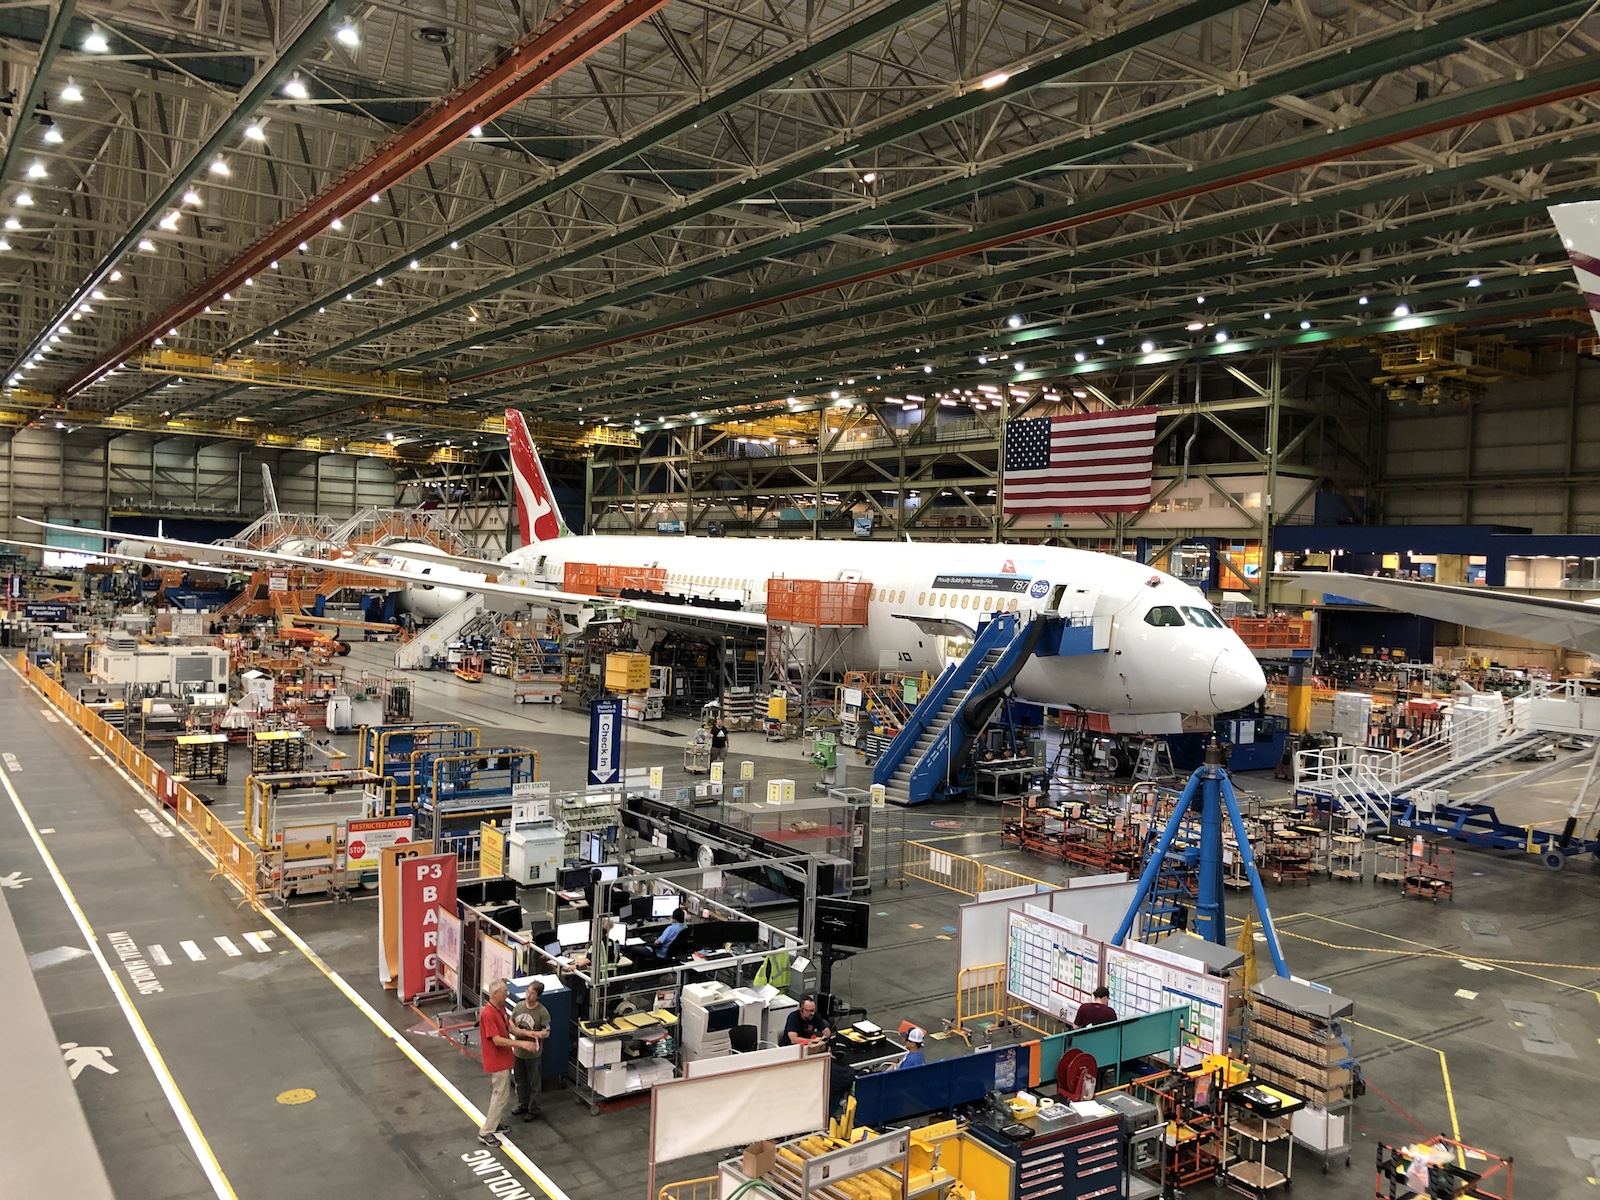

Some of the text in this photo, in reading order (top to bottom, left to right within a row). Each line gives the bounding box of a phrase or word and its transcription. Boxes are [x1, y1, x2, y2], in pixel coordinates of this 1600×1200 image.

[1011, 579, 1030, 589] 787
[1031, 584, 1049, 593] 929
[600, 723, 610, 767] Check In
[351, 820, 410, 830] RESTRICTED ACCESS
[349, 846, 365, 854] STOP
[416, 863, 443, 881] P3
[106, 930, 165, 995] MATERIAL HANDLING
[461, 1149, 536, 1200] NDLING
